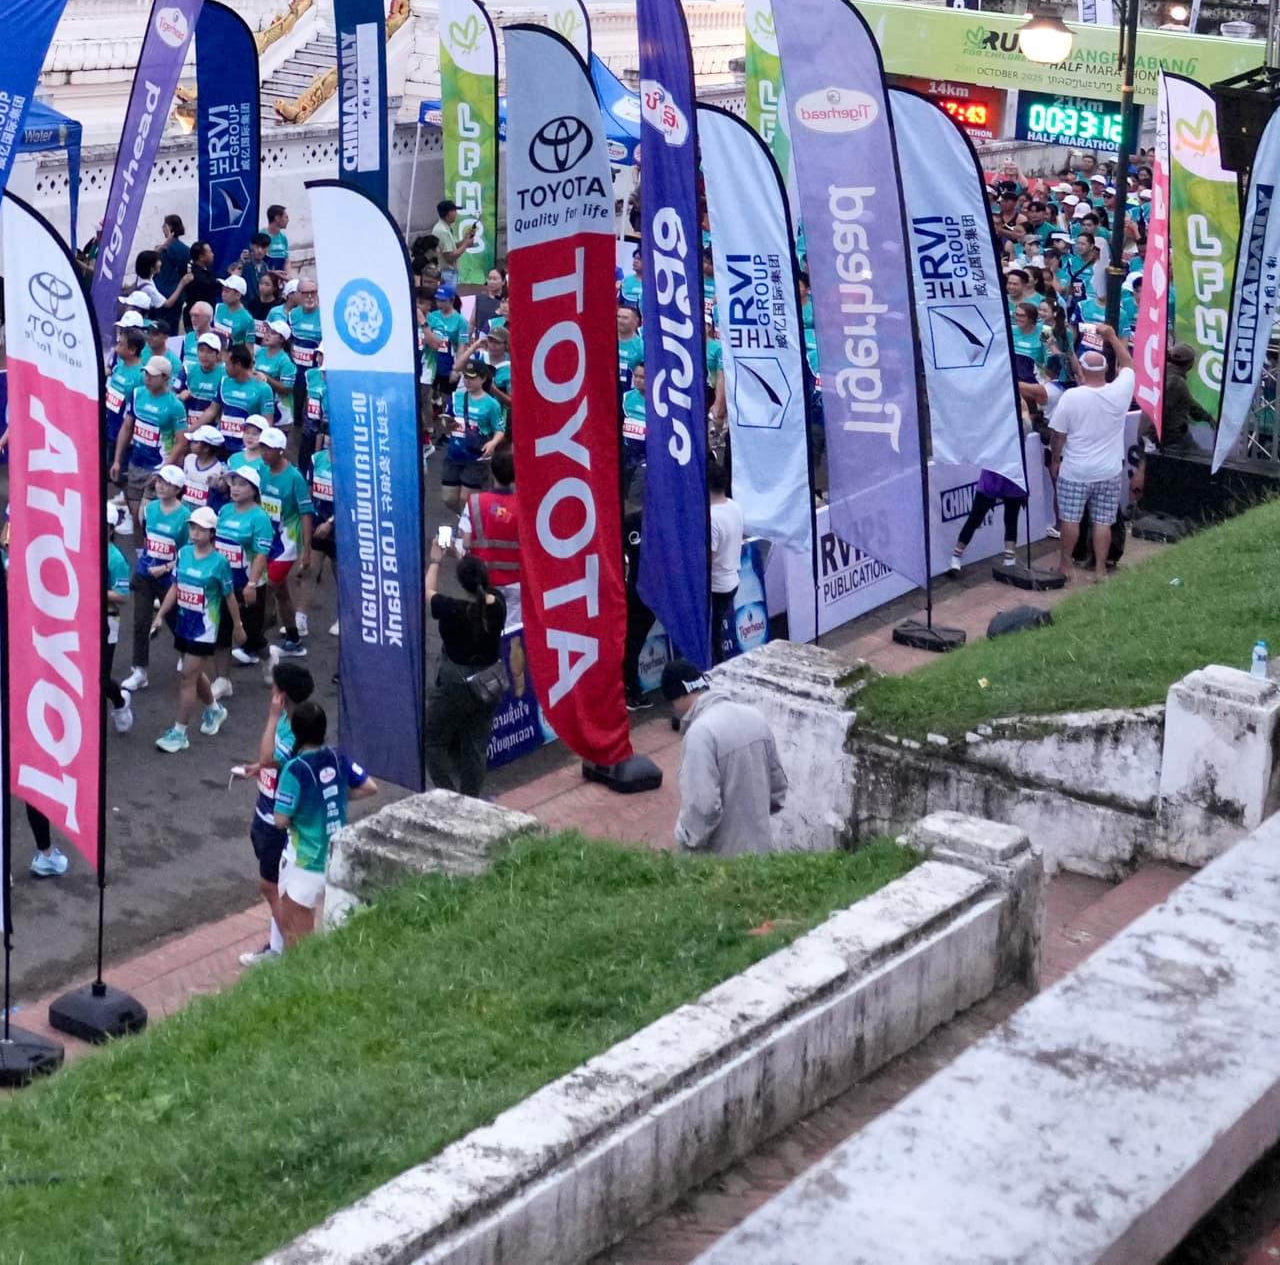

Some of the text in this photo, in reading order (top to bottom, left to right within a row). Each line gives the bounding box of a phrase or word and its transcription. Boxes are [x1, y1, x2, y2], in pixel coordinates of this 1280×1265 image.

[928, 81, 970, 98] 14km
[976, 67, 1019, 80] OCTOBER
[1050, 61, 1157, 81] HALF MARAHON
[341, 31, 358, 171] CHINADAILY
[1054, 94, 1104, 113] 21km
[207, 105, 230, 157] RVI
[229, 104, 240, 156] GROUP
[1027, 130, 1058, 145] HALF
[99, 81, 161, 280] Tigerhead
[517, 176, 606, 210] TOYOTA
[514, 211, 559, 233] Quality
[582, 204, 608, 218] life
[912, 216, 953, 280] RVI
[945, 216, 968, 278] GROUP
[726, 254, 758, 326] RVI
[753, 254, 770, 326] GROUP
[1233, 186, 1273, 382] CHINADAILY
[532, 247, 599, 709] TOYOTA
